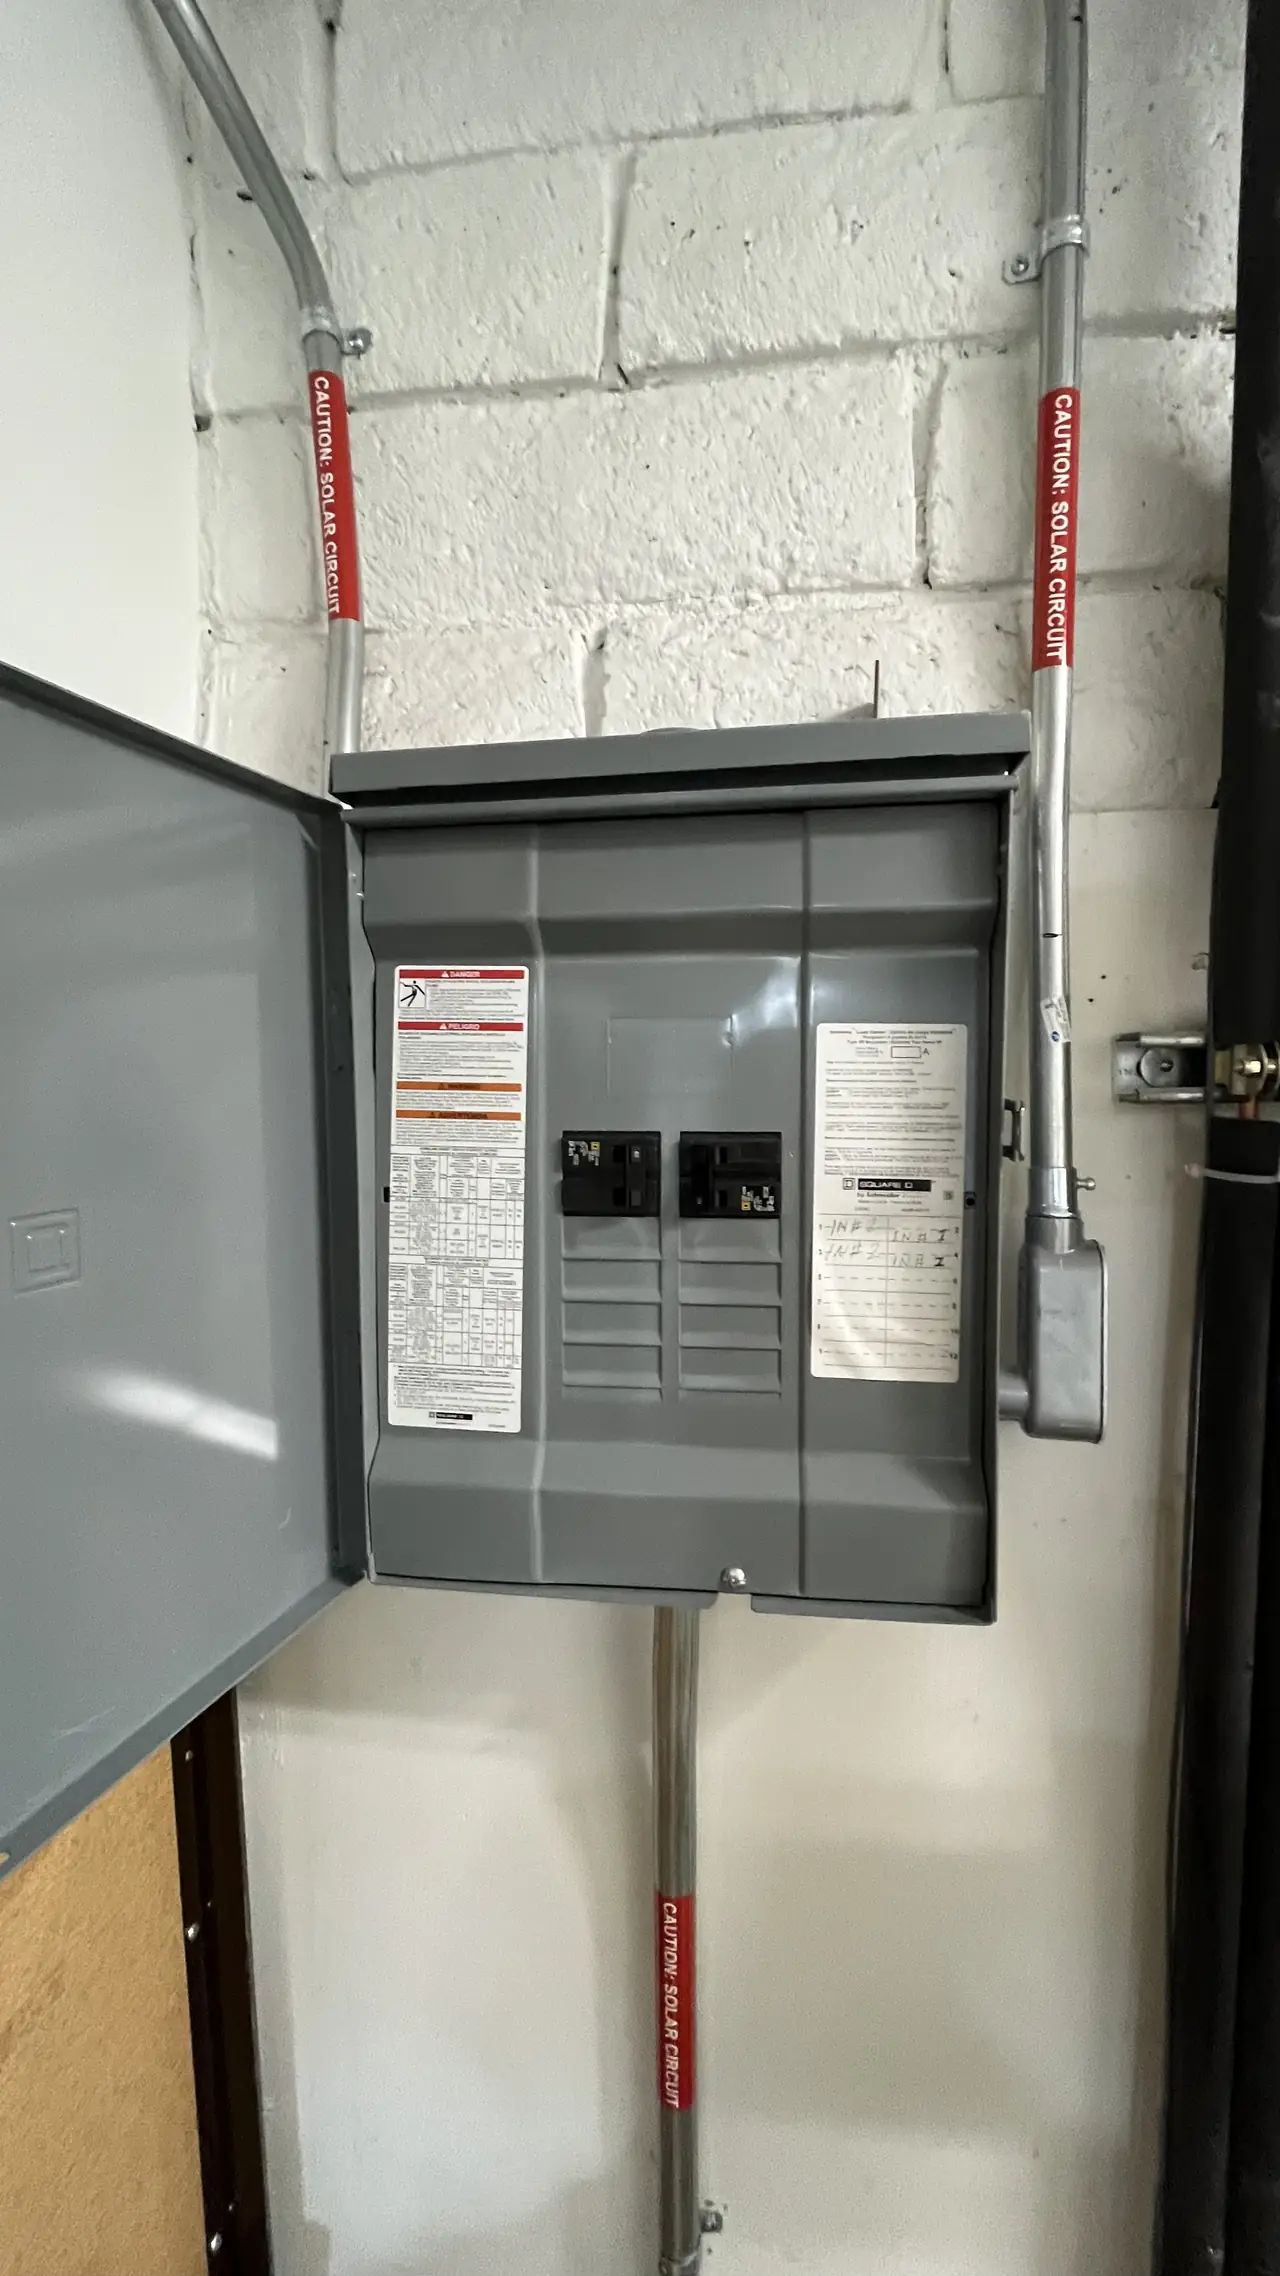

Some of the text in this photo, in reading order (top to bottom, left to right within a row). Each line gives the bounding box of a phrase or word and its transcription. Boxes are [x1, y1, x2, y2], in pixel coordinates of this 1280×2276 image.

[314, 376, 341, 614] CAUTION: SOLAR CIRCUIT
[1046, 394, 1072, 666] CAUTION: SOLAR CIRCUIT
[922, 1047, 930, 1056] A
[859, 1180, 902, 1188] SQUARE
[663, 1902, 680, 2108] CAUTION: SOLAR CIRCUIT
